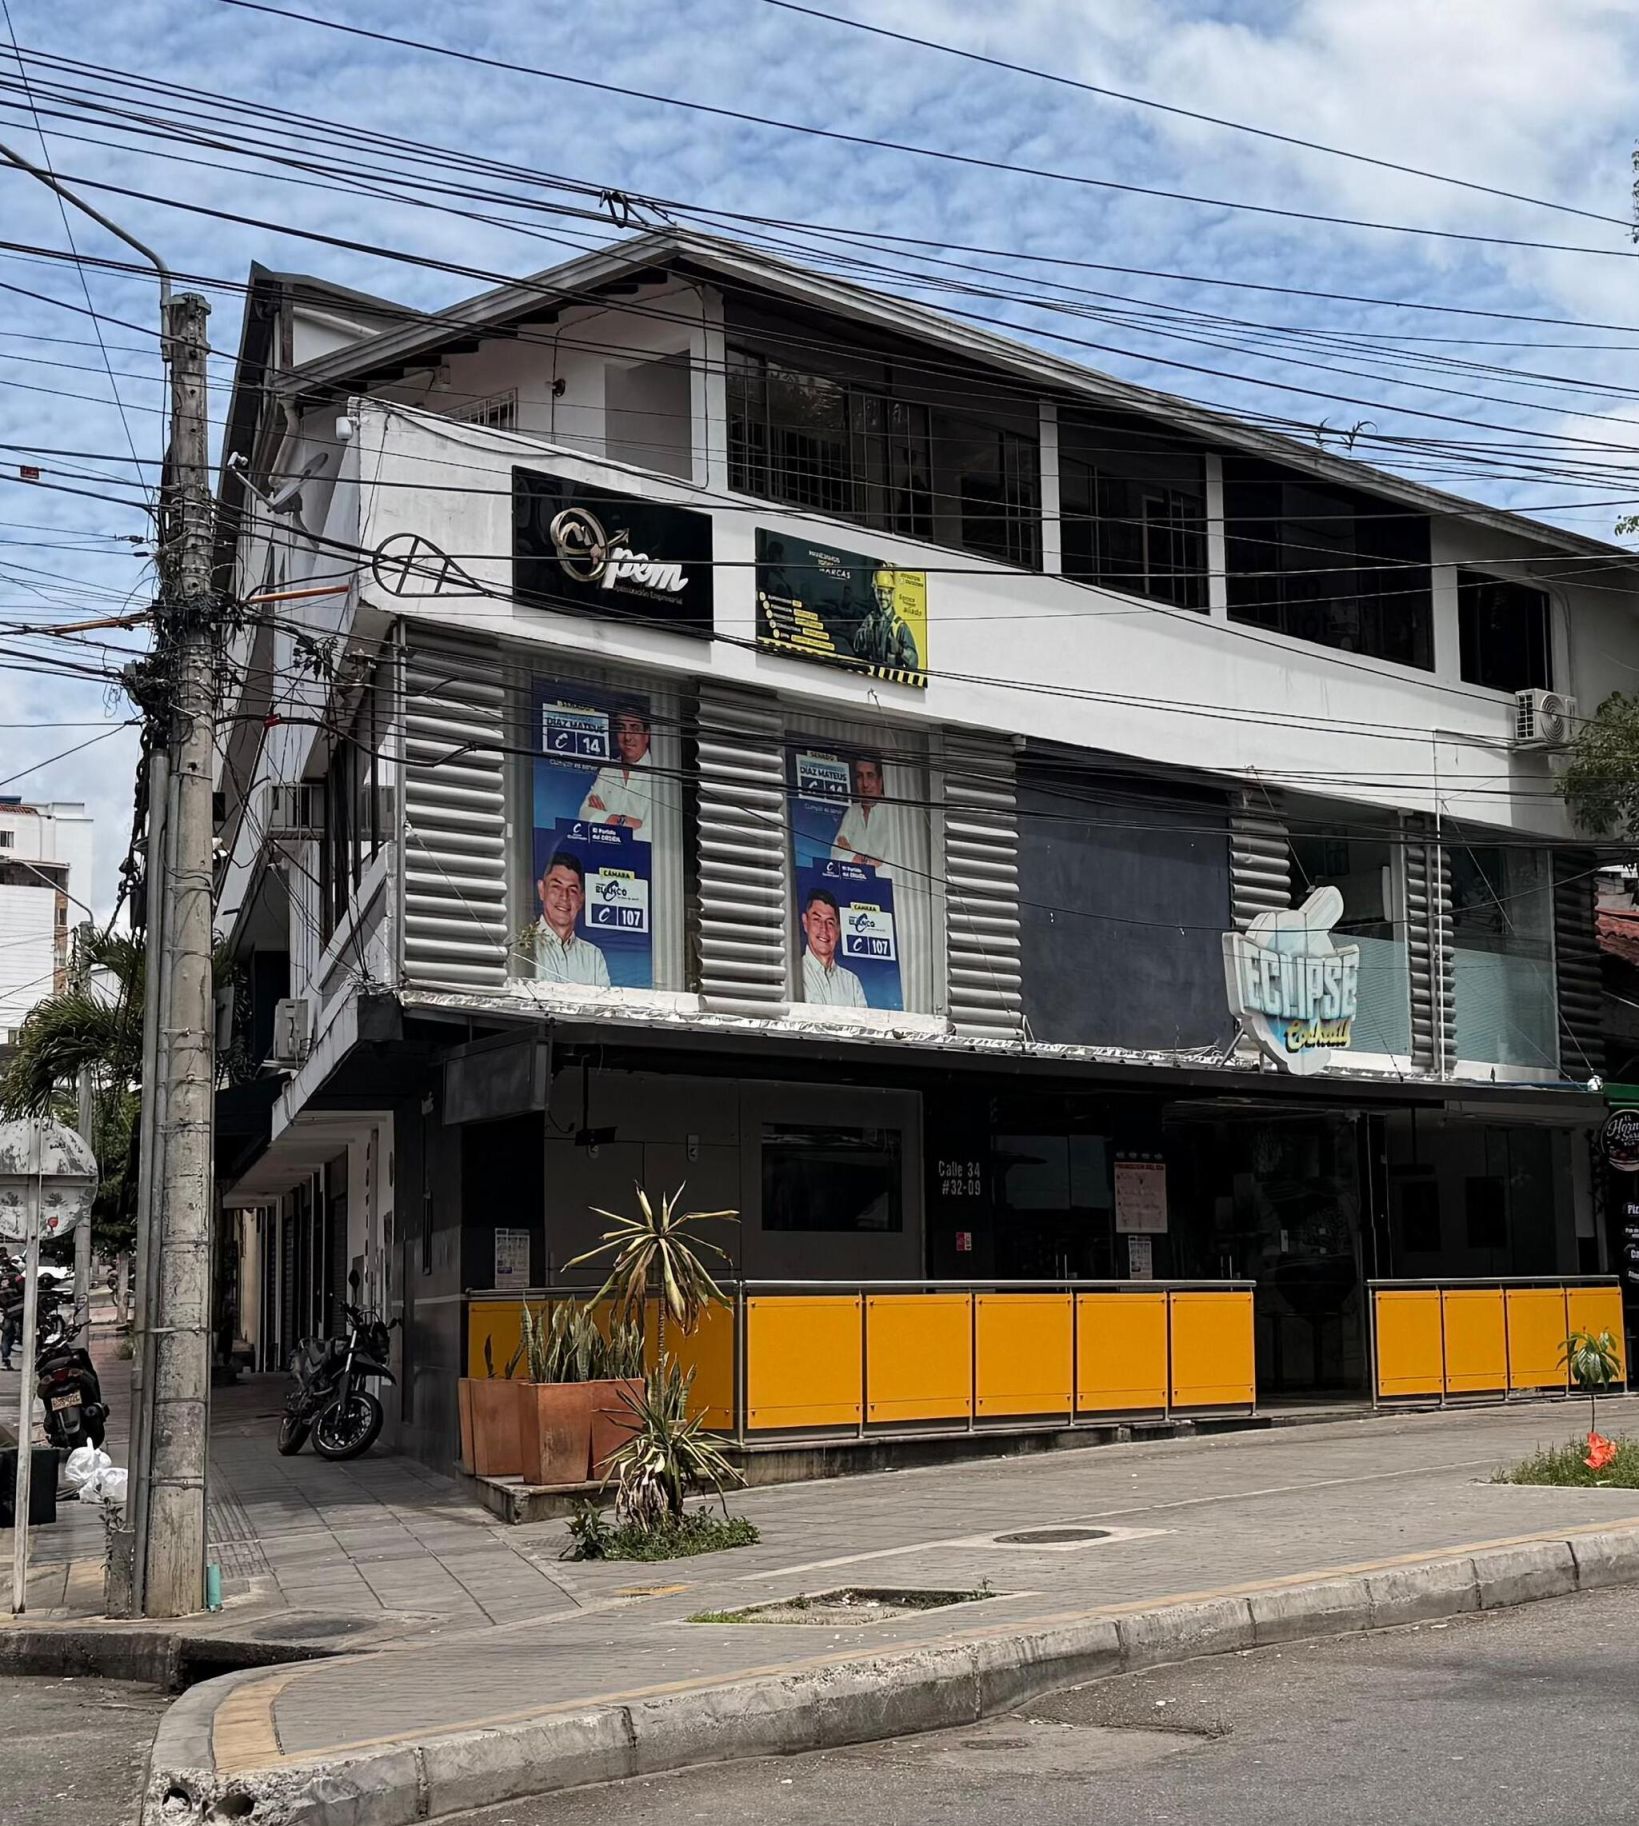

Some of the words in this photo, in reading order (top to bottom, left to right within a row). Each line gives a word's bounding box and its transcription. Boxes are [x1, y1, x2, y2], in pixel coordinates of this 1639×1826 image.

[583, 737, 600, 753] 14
[622, 910, 640, 926] 107
[872, 939, 887, 955] 107
[1241, 940, 1359, 1020] ECLIPSE
[938, 1160, 963, 1177] Calle
[967, 1161, 981, 1178] 34
[942, 1179, 981, 1196] #32-09
